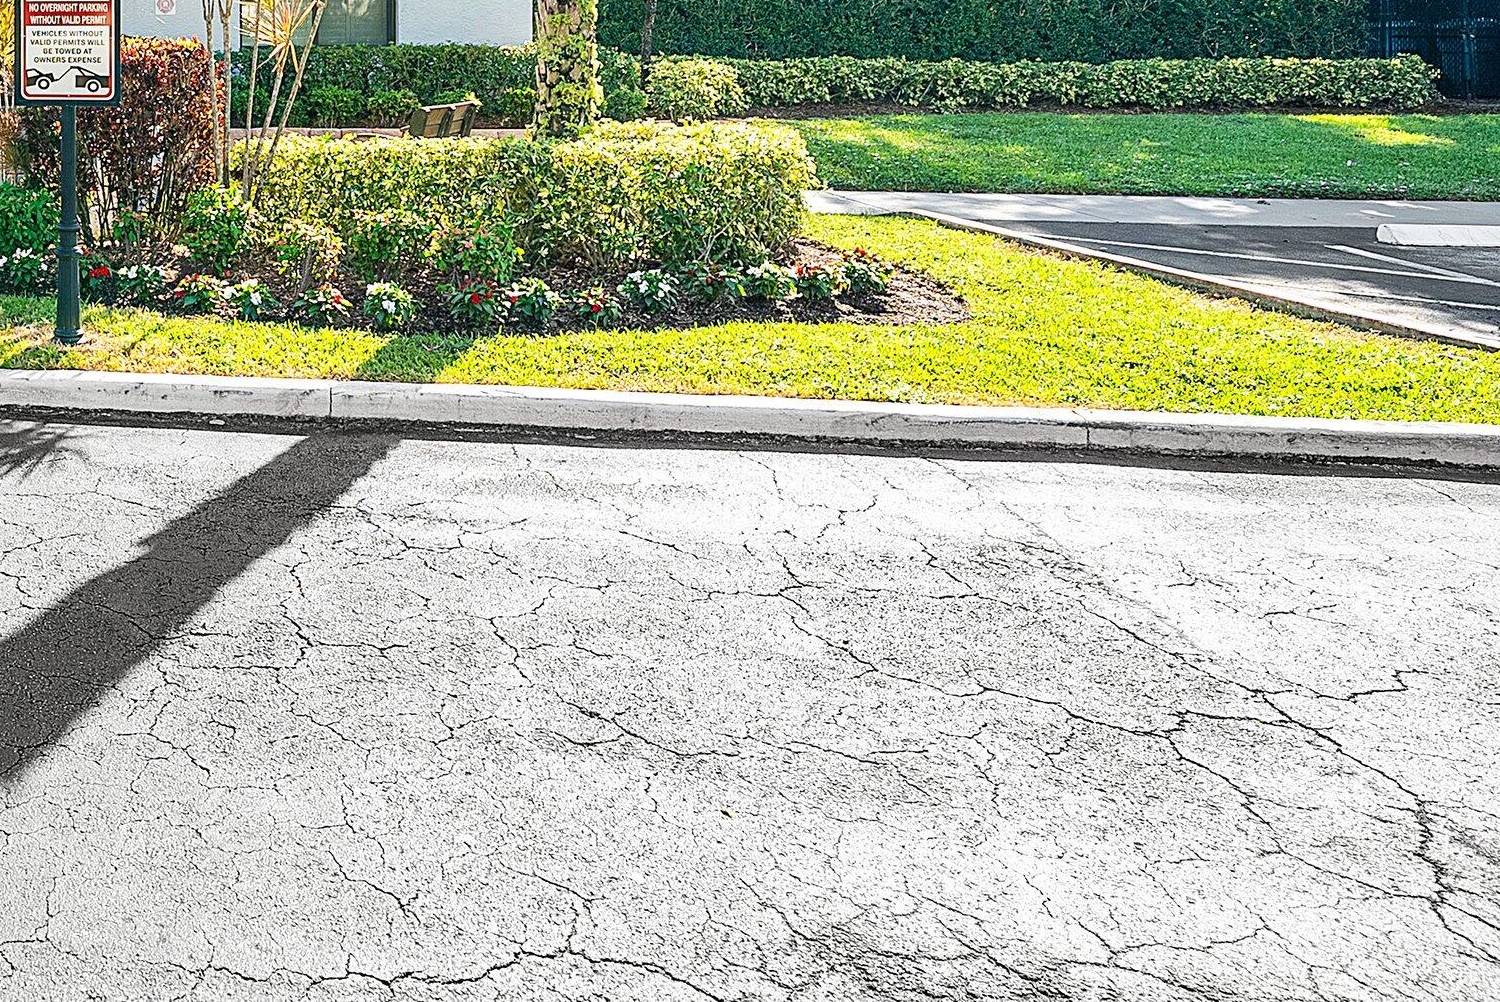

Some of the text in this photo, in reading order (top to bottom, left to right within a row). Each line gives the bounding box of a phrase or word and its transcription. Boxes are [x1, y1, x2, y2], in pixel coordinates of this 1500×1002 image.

[28, 3, 108, 12] NO OVERNIGHT PARKING
[29, 15, 107, 24] WITHOUT VALID PERMIT
